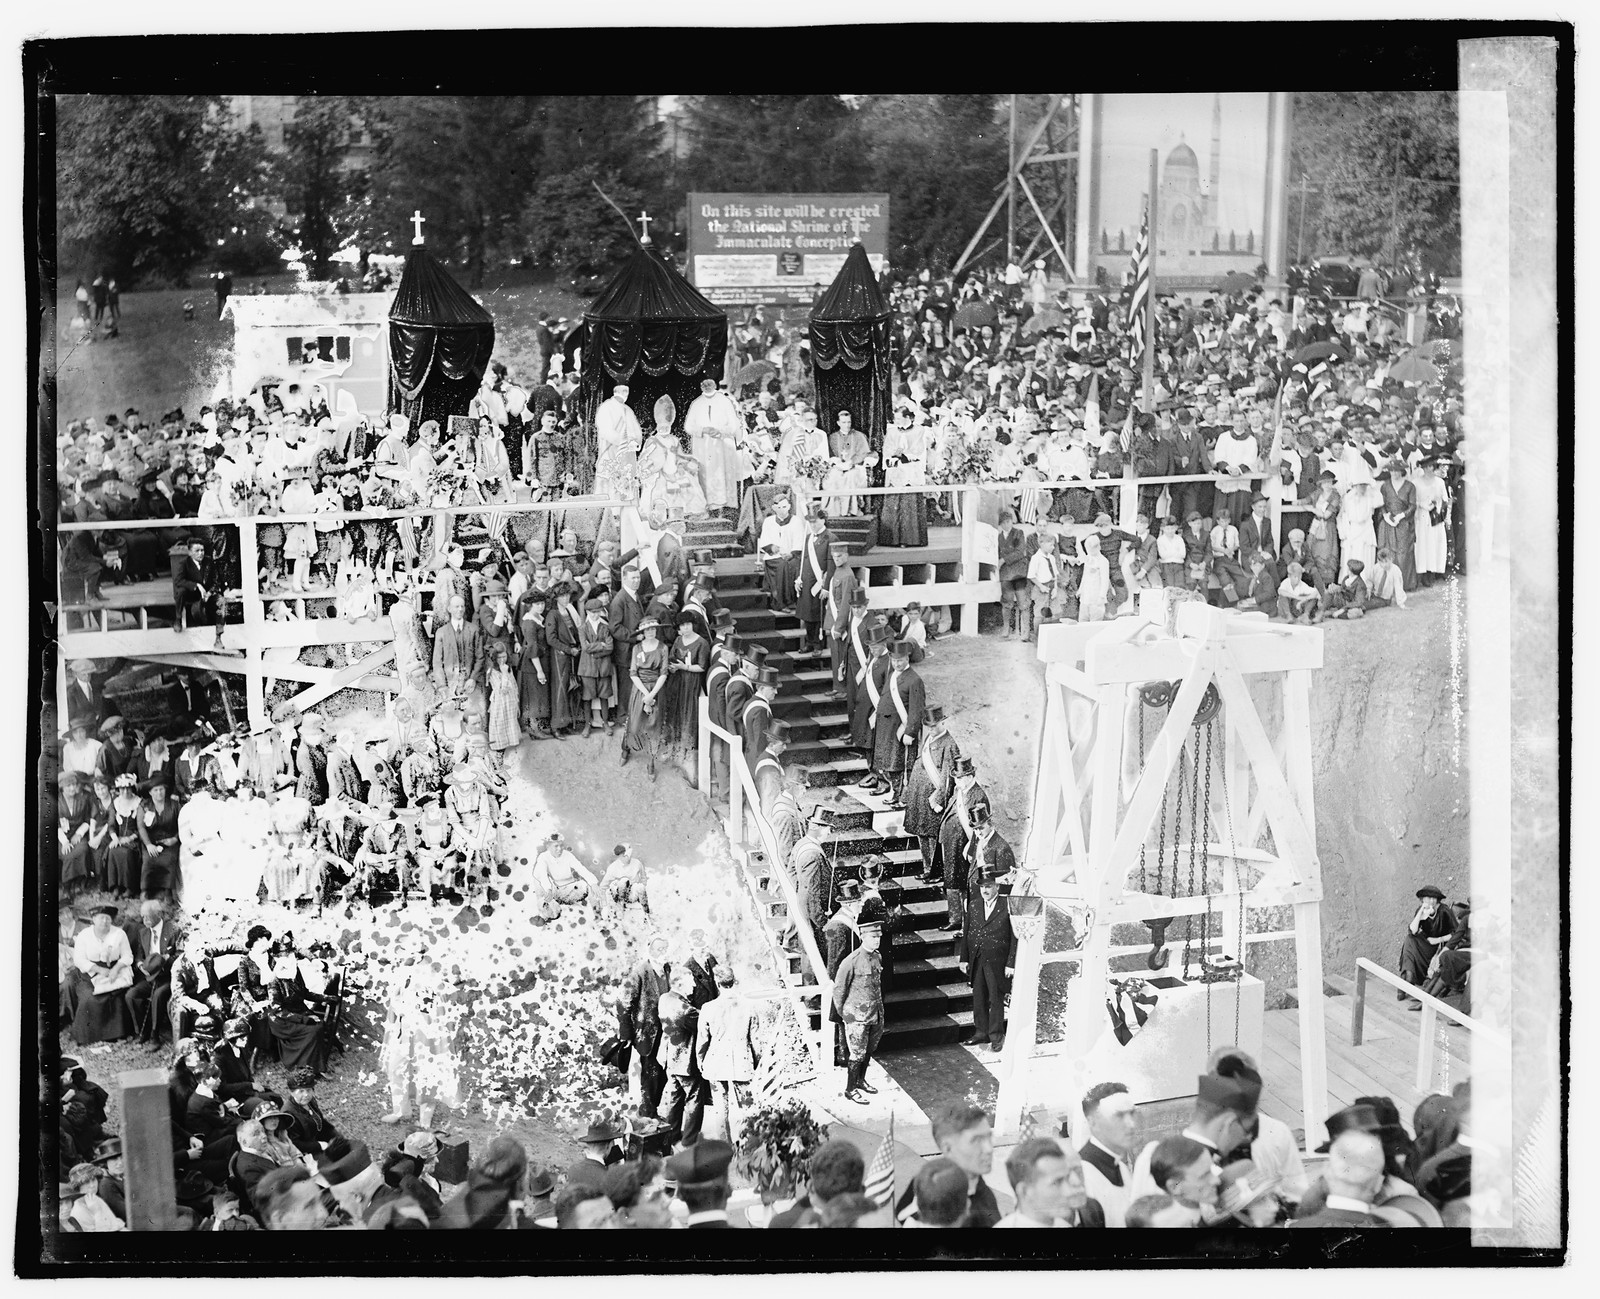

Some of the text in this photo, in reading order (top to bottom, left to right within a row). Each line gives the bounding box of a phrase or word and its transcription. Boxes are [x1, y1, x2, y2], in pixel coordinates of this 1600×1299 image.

[701, 204, 881, 218] On this site will be erected
[708, 219, 730, 233] the
[731, 219, 787, 233] National
[789, 219, 832, 233] Shrine
[833, 219, 848, 233] of
[715, 235, 793, 249] Immaculate
